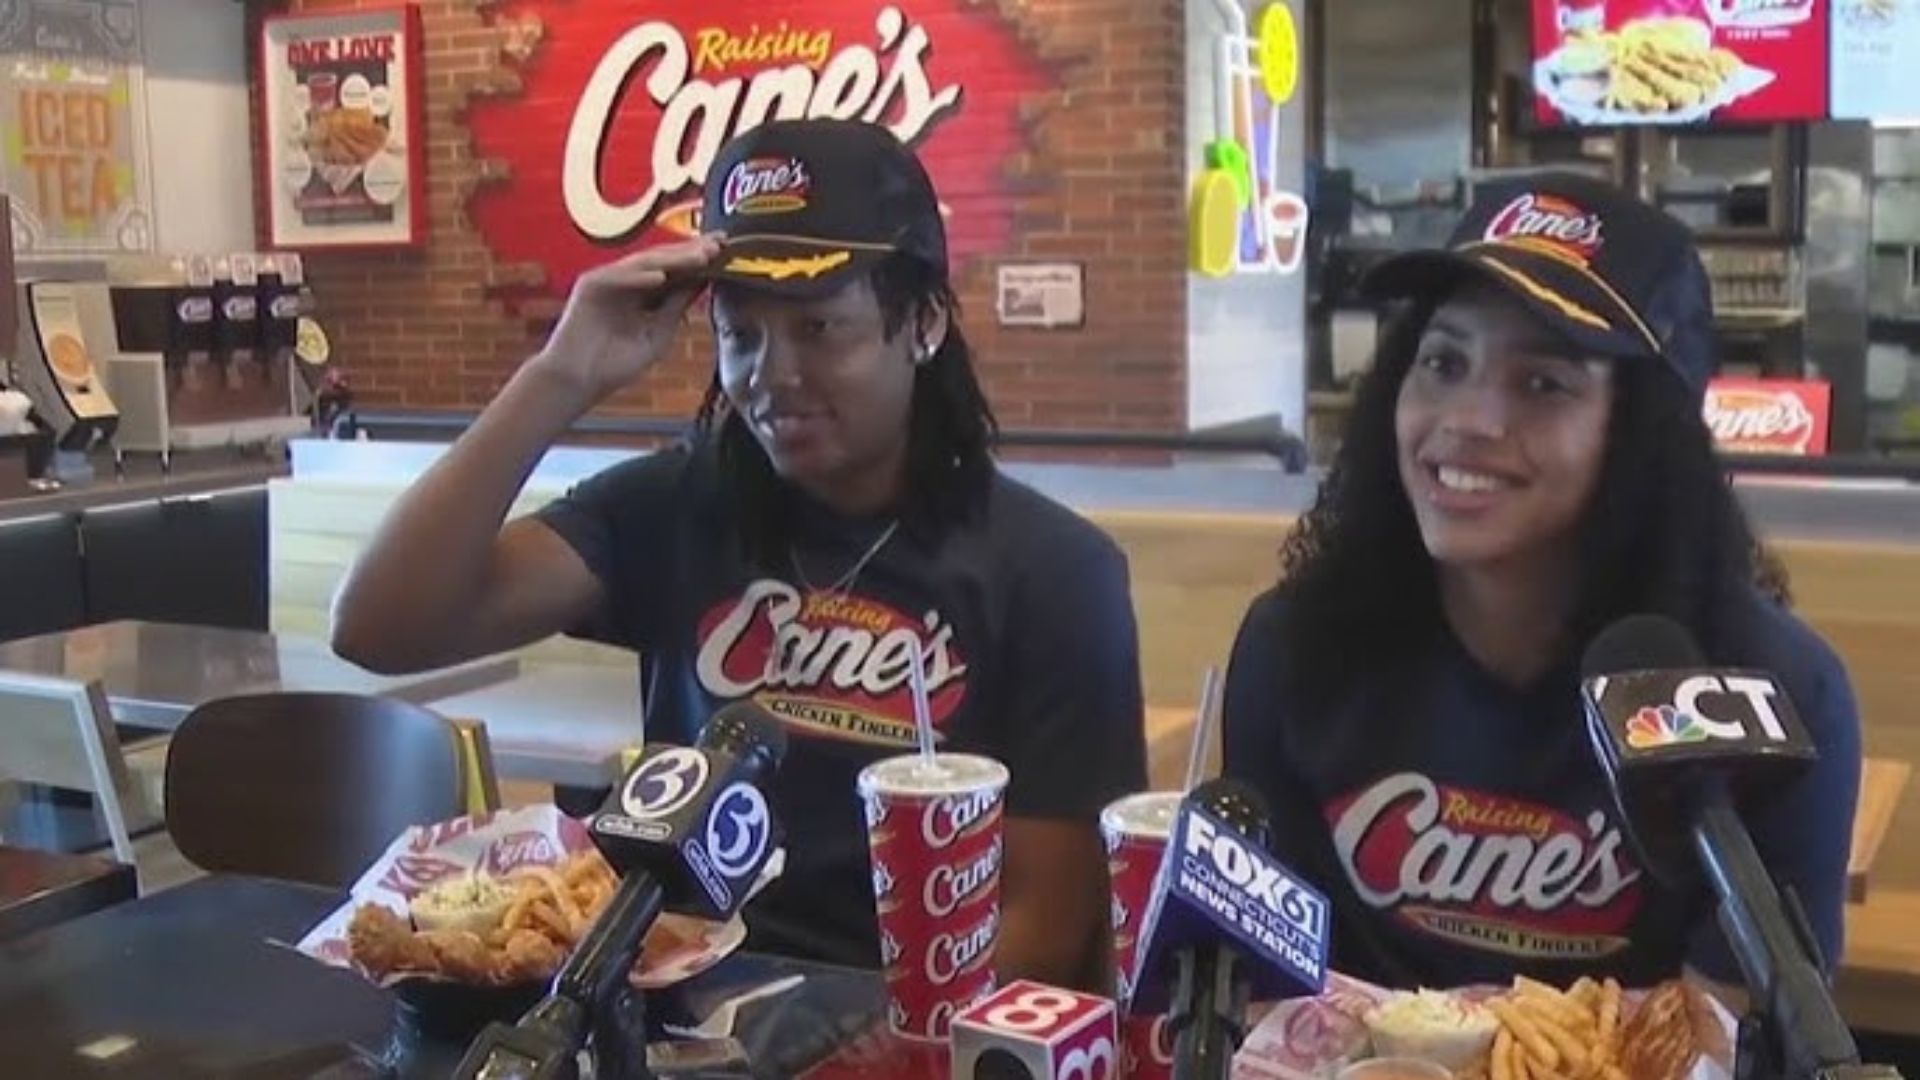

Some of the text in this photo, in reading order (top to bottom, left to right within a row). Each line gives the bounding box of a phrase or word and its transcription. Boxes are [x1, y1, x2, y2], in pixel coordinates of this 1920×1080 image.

[337, 35, 396, 62] LOVE
[697, 25, 833, 70] Raising
[20, 89, 113, 149] ICED
[562, 6, 962, 240] Cane's
[22, 153, 118, 221] TEA
[723, 157, 809, 217] Cane's
[1483, 192, 1605, 245] Cane's
[696, 578, 967, 698] Cane's
[771, 699, 841, 729] CHICKEN
[1674, 675, 1787, 742] CT
[1333, 771, 1643, 911] Cane's
[1443, 790, 1553, 841] Raising
[1180, 869, 1238, 922] NEWS
[1240, 912, 1320, 981] STATION
[985, 990, 1078, 1032] 8
